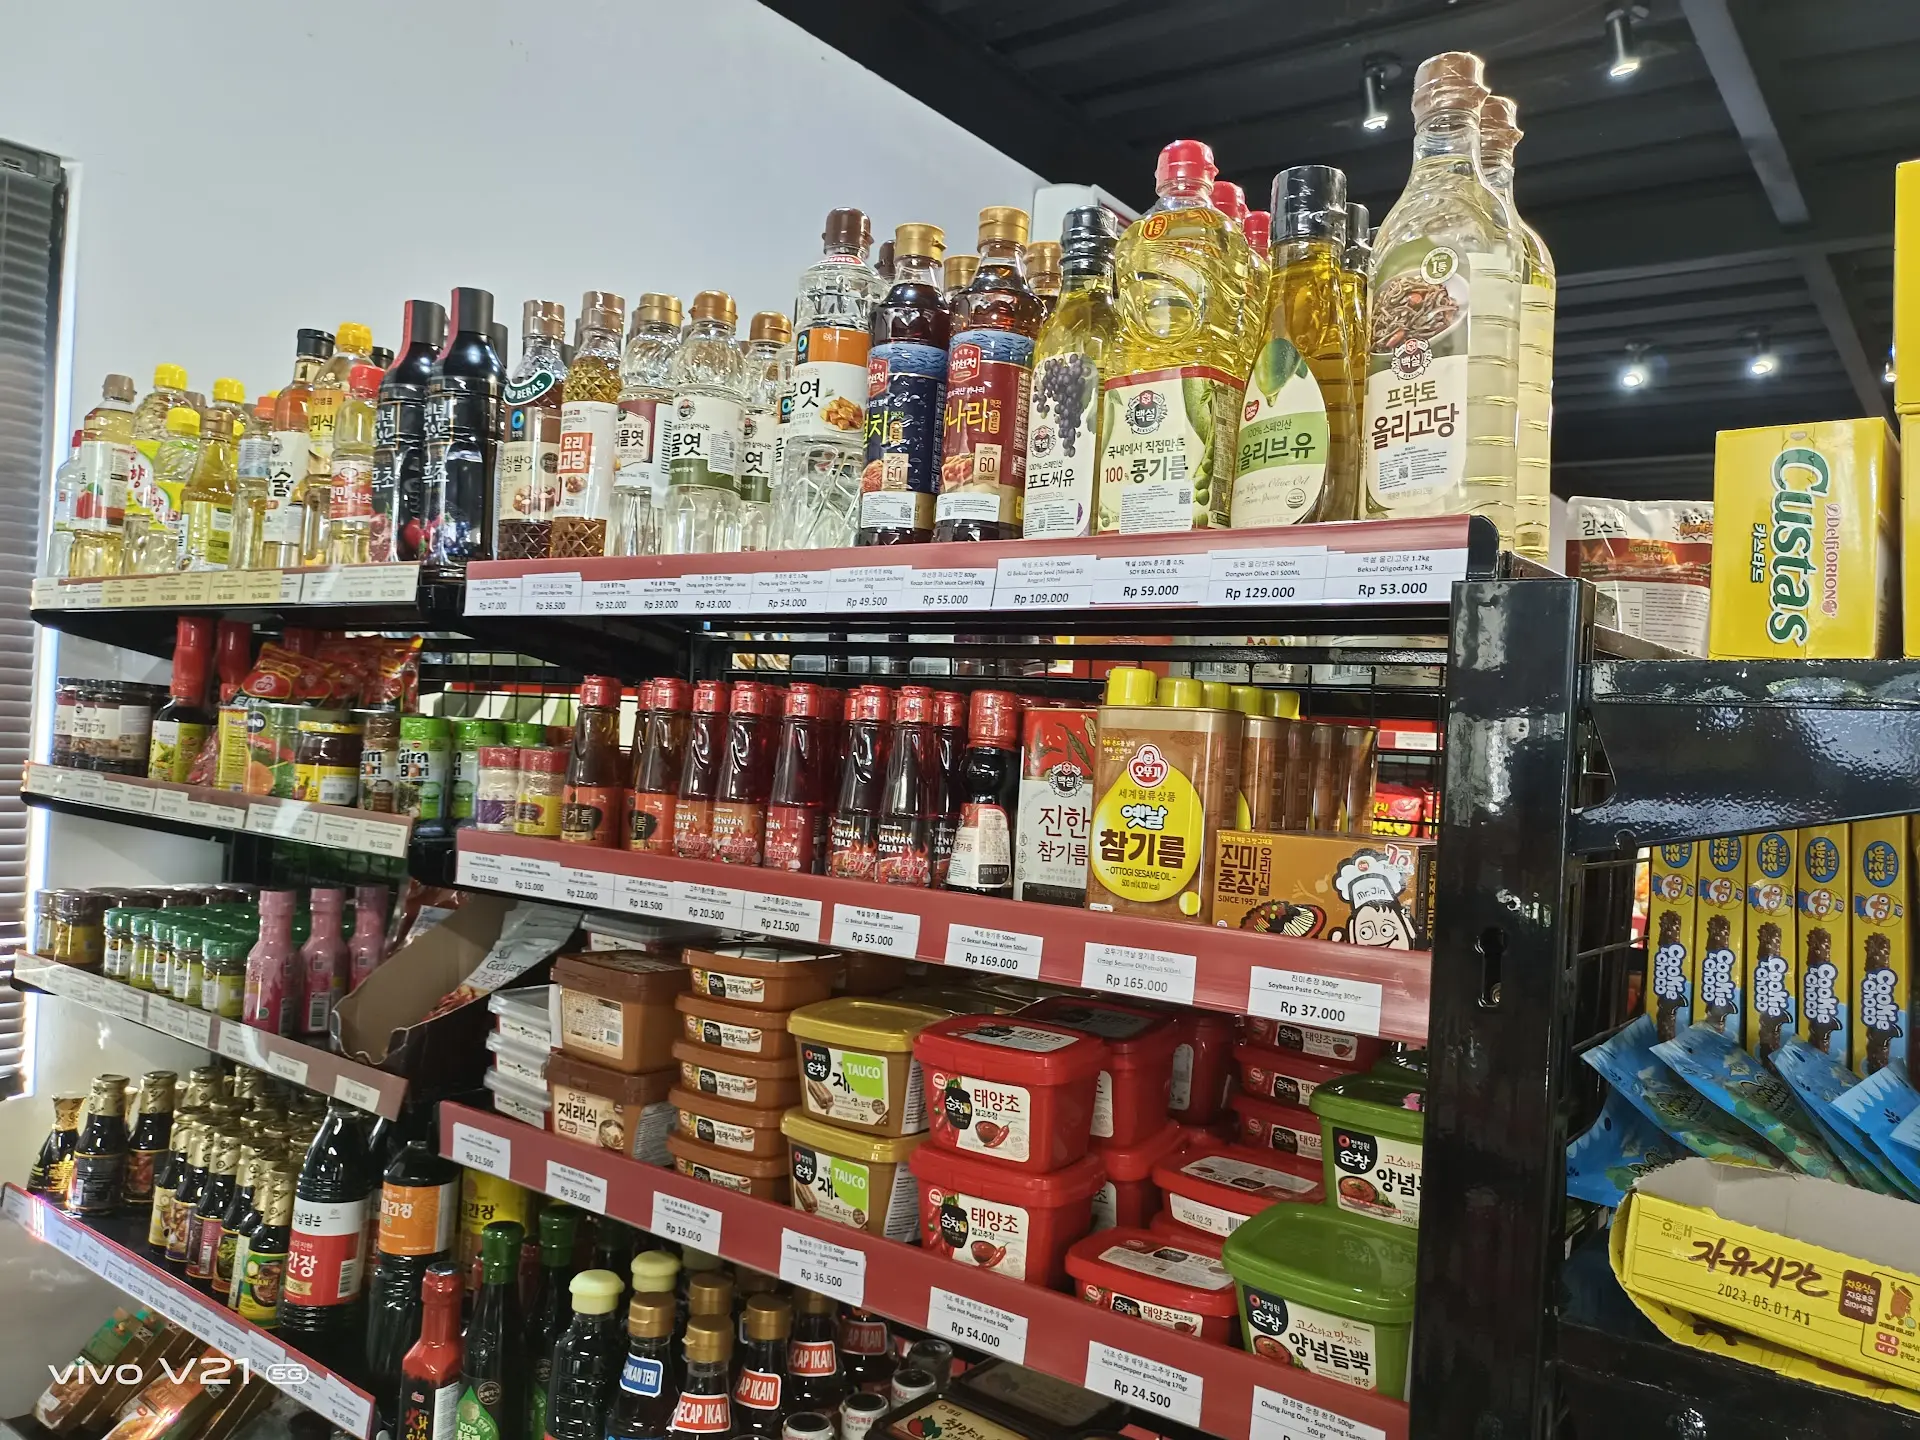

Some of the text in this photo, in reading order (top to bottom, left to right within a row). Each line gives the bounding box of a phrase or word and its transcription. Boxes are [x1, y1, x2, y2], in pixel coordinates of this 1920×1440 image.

[1401, 354, 1420, 368] 백설
[517, 381, 545, 399] BERAS
[1385, 381, 1438, 409] 프락토
[1134, 409, 1156, 422] 백설
[1263, 419, 1292, 434] 스페인산
[1372, 404, 1459, 449] 올리고당
[564, 436, 583, 450] 요리
[1107, 437, 1185, 459] 국내에서 직접만든
[1240, 433, 1316, 470] 올리브유
[560, 450, 586, 469] 고당
[979, 457, 995, 473] 60
[422, 462, 449, 487] 흑초
[1130, 455, 1188, 484] 콩기름
[1028, 469, 1075, 490] 포도씨유
[1751, 523, 1766, 583] 카스타드
[1767, 448, 1829, 646] Custas
[1380, 565, 1412, 573] Oligodang
[1123, 585, 1179, 597] Rp 59.000
[1226, 587, 1295, 600] Rp 129.000
[1358, 583, 1428, 597] Rp 53.000
[536, 602, 566, 610] Rp 36.500
[605, 601, 627, 609] 32.000
[644, 601, 652, 609] Rp
[695, 600, 731, 609] Rp 43.000
[768, 599, 807, 608] Rp 54.000
[847, 597, 887, 607] Rp 49.500
[923, 595, 968, 605] Rp 55.000
[1014, 594, 1069, 605] Rp 109.000
[1058, 774, 1075, 787] 백설
[1134, 766, 1161, 779] 오뚜기
[1118, 789, 1176, 803] 세계일류상품
[1038, 805, 1090, 838] 진한
[1121, 803, 1168, 831] 옛날
[879, 833, 913, 845] MINYAK
[878, 845, 903, 853] CABAI
[1038, 842, 1088, 866] 참기름
[1099, 829, 1186, 869] 참기름
[1221, 844, 1257, 870] 진미
[471, 874, 498, 885] Rp 12.500
[1110, 867, 1171, 881] OTTOGI SESAME OIL
[1260, 848, 1272, 896] 오리지널
[515, 881, 544, 892] Rp 15.000
[1218, 870, 1258, 894] 춘장
[567, 889, 598, 900] Rp 22.000
[1218, 895, 1258, 905] SINCE 1957
[629, 899, 663, 910] Rp 18.500
[689, 907, 724, 920] Rp 20.500
[761, 919, 799, 932] Rp 21.500
[852, 932, 893, 946] Rp 55.000
[965, 953, 1018, 969] Rp 169.000
[1106, 974, 1168, 993] Rp 165.000
[1291, 975, 1320, 986] 진미춘장
[1268, 981, 1342, 1000] Soybean Paste Chunjang
[1280, 1002, 1345, 1022] Rp 37.000
[1305, 1032, 1331, 1044] 태양초
[807, 1062, 827, 1077] 순창
[847, 1063, 881, 1079] TAUCO
[974, 1089, 1020, 1113] 태양초
[558, 1102, 597, 1127] 재래식
[1351, 1140, 1370, 1150] 청정원
[466, 1152, 494, 1168] Rp 21.500
[1340, 1151, 1371, 1170] 순창
[795, 1164, 813, 1181] 순창
[834, 1168, 866, 1190] TAUCO
[560, 1186, 591, 1203] Rp 35.000
[971, 1208, 1019, 1234] 태양초
[666, 1222, 702, 1242] Rp 19.000
[1661, 1231, 1682, 1241] HAITAI
[288, 1252, 318, 1278] 간장
[1689, 1238, 1829, 1297] 자유시간
[801, 1269, 842, 1287] Rp 36.500
[1143, 1304, 1173, 1322] 태양초
[1261, 1301, 1280, 1313] 청정원
[1252, 1310, 1282, 1332] 순창
[951, 1322, 1000, 1347] Rp 54.000
[1295, 1320, 1363, 1346] 고소하고 맛있는
[810, 1347, 832, 1368] IKAN
[1289, 1333, 1371, 1375] 양념듬뿍
[1101, 1358, 1187, 1391] Sajo Hotpepper 170gr
[1172, 1372, 1187, 1382] 170gr
[751, 1380, 775, 1402] IKAN
[1114, 1379, 1171, 1408] Rp 24.500
[704, 1400, 728, 1424] IKAN
[1261, 1400, 1344, 1436] Chung Jung One Sunchang
[1307, 1427, 1318, 1436] 500
